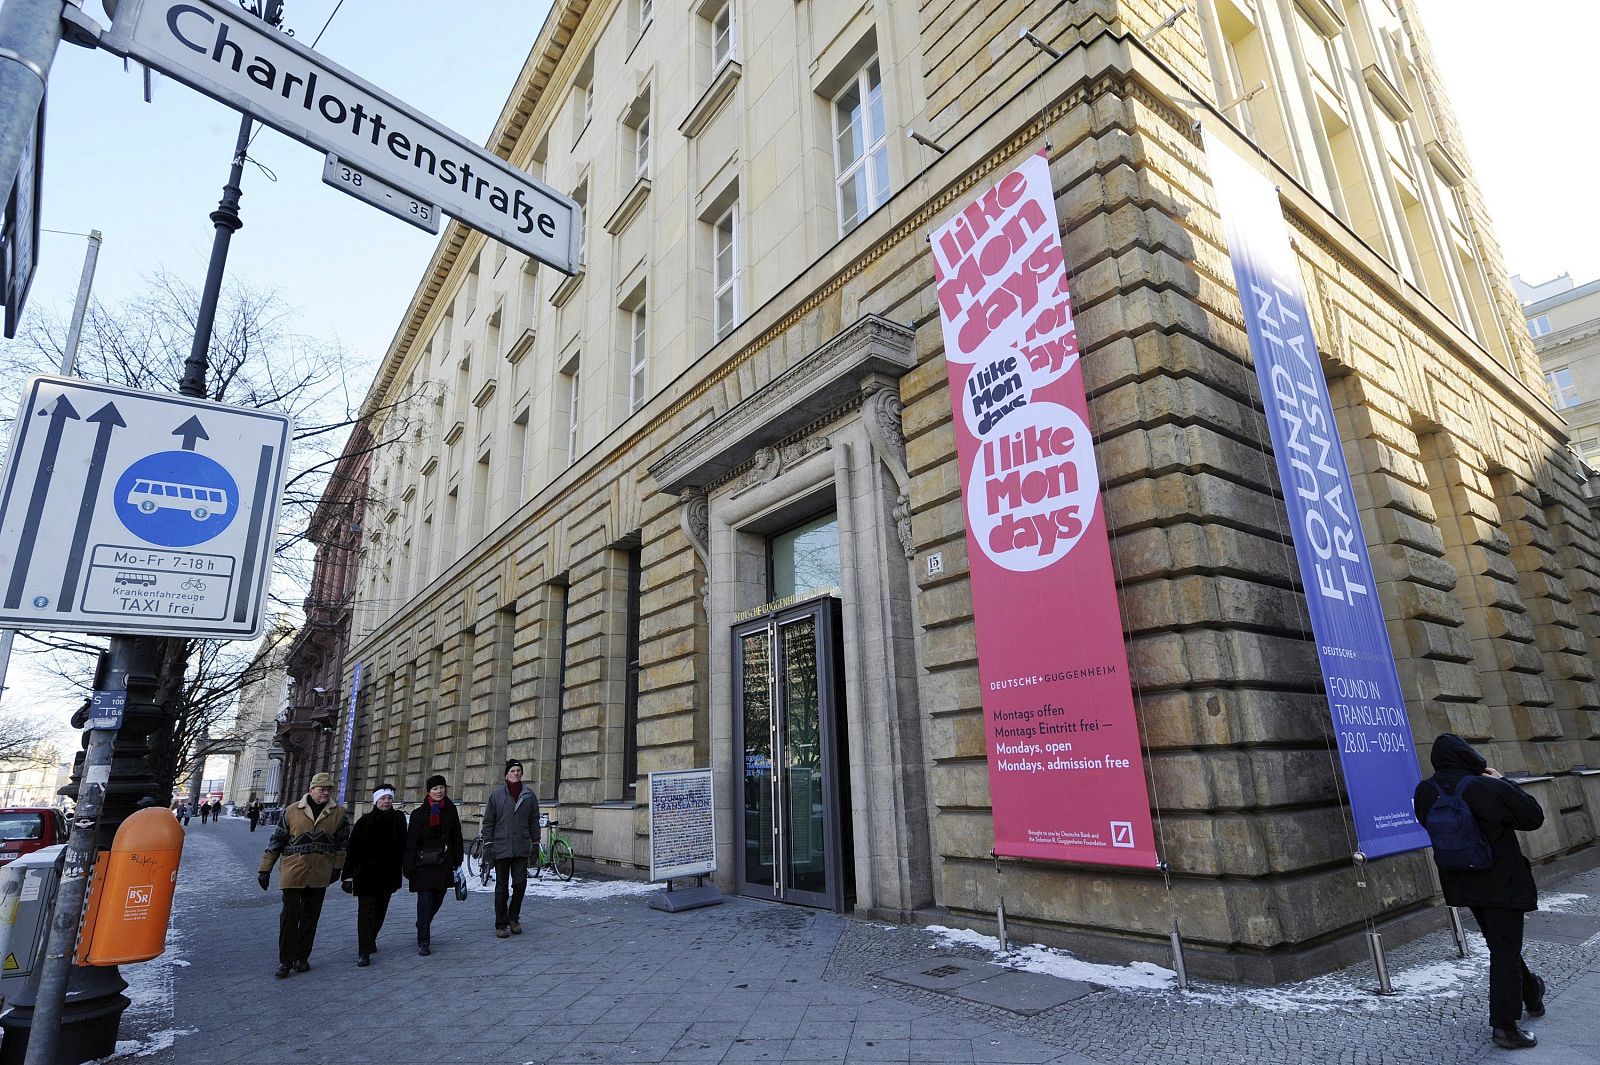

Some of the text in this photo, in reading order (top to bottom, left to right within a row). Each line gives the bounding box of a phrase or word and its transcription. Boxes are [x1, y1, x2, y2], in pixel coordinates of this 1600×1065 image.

[165, 4, 556, 239] Charlottenstraße
[340, 166, 363, 188] 38
[408, 200, 429, 220] 35
[939, 171, 1028, 270] like
[937, 199, 1048, 323] Mon
[958, 233, 1065, 354] days
[968, 356, 1018, 397] I like
[972, 373, 1022, 417] Mon
[983, 425, 1075, 477] I like
[1250, 283, 1345, 602] FOUND IN
[985, 460, 1079, 516] Mon
[988, 505, 1083, 556] days
[114, 552, 215, 571] Mo-Fr 7-18 h
[929, 555, 940, 569] 15
[113, 587, 205, 602] Krankenfahrzeuge
[120, 598, 195, 615] TAXI frei
[1329, 676, 1381, 700] FOUND IN
[94, 696, 102, 705] S
[993, 704, 1065, 723] Montags offen
[1335, 704, 1406, 727] TRANSLATION
[995, 724, 1036, 739] Montags
[1039, 721, 1077, 735] Eintritt
[1080, 719, 1099, 732] frei
[996, 740, 1072, 756] Mondays, open
[998, 755, 1130, 773] Mondays, admission free
[129, 889, 149, 904] BSR
